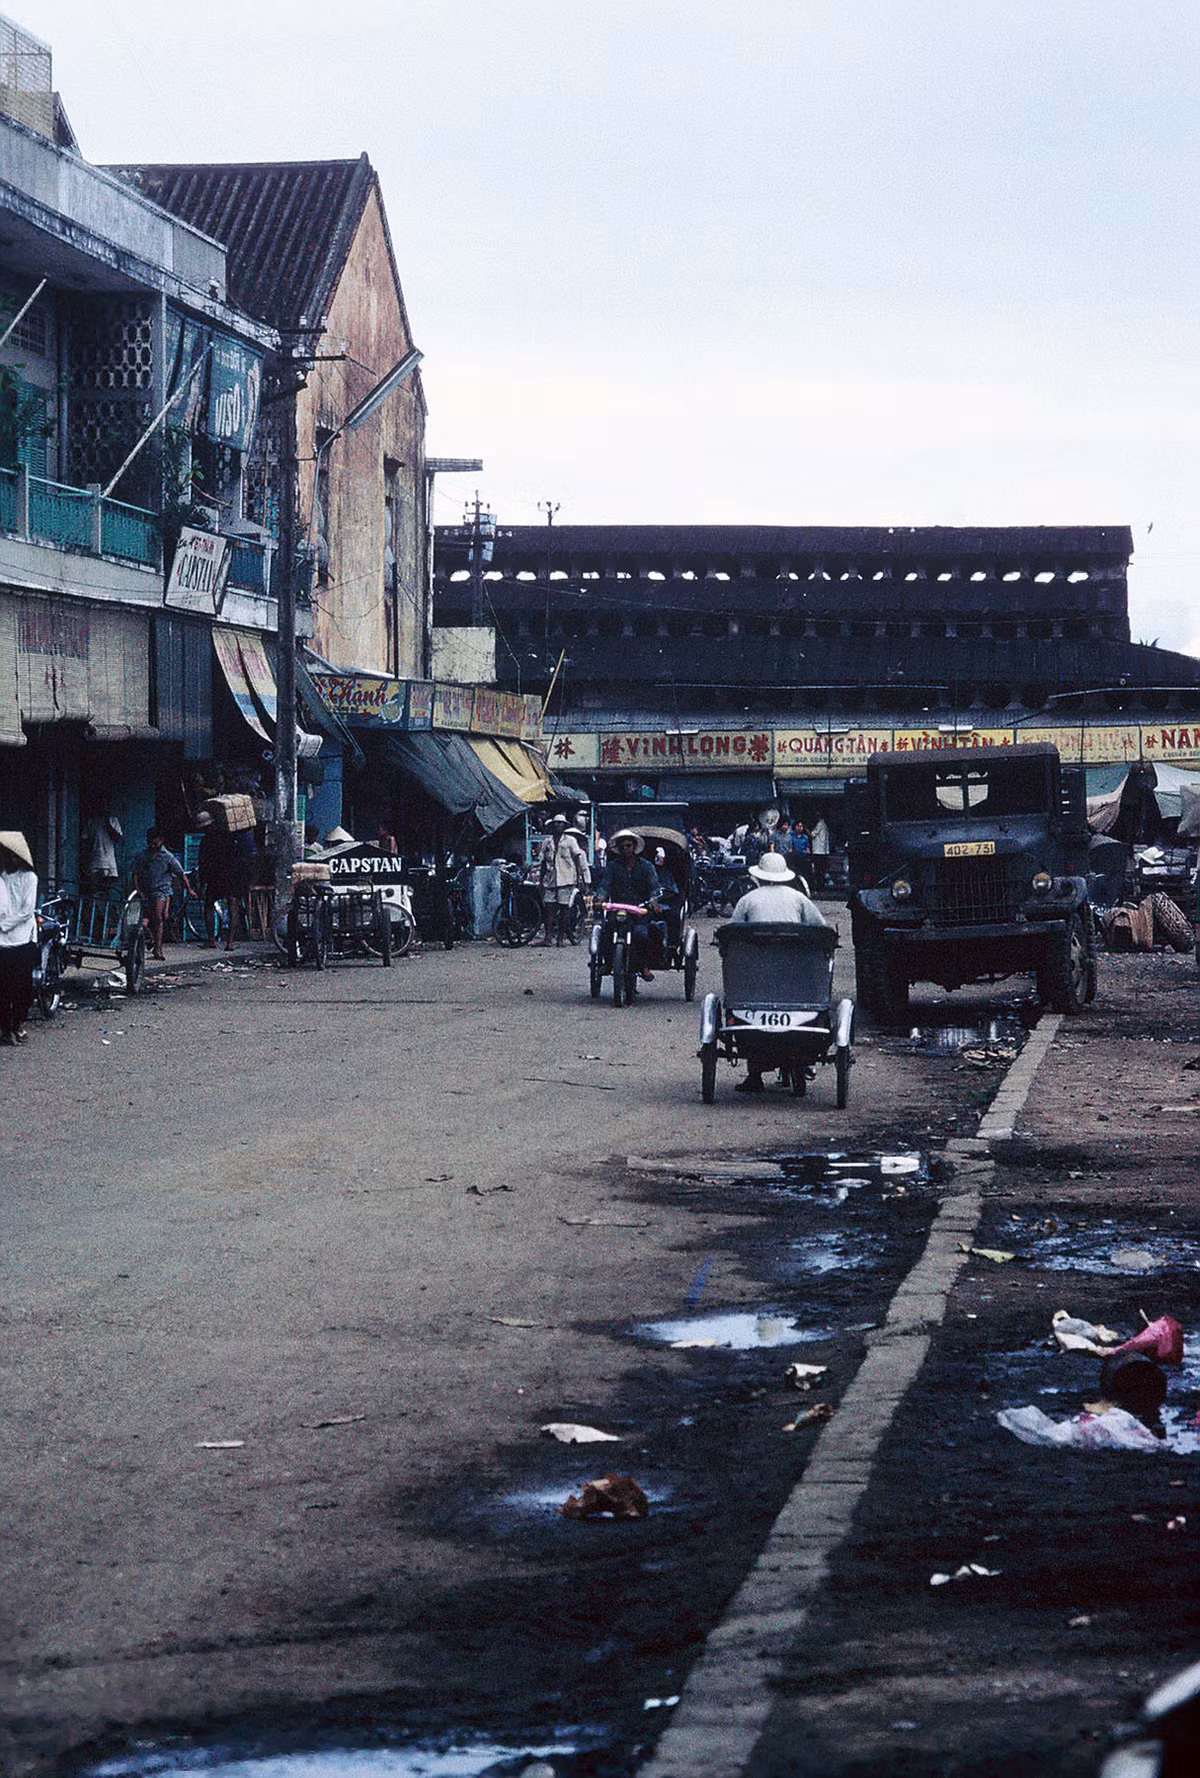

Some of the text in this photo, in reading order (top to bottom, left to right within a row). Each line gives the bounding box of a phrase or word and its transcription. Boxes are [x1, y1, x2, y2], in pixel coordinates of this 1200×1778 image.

[688, 736, 747, 756] LONG
[329, 856, 403, 874] CAPSTAN
[759, 1012, 791, 1027] 160
